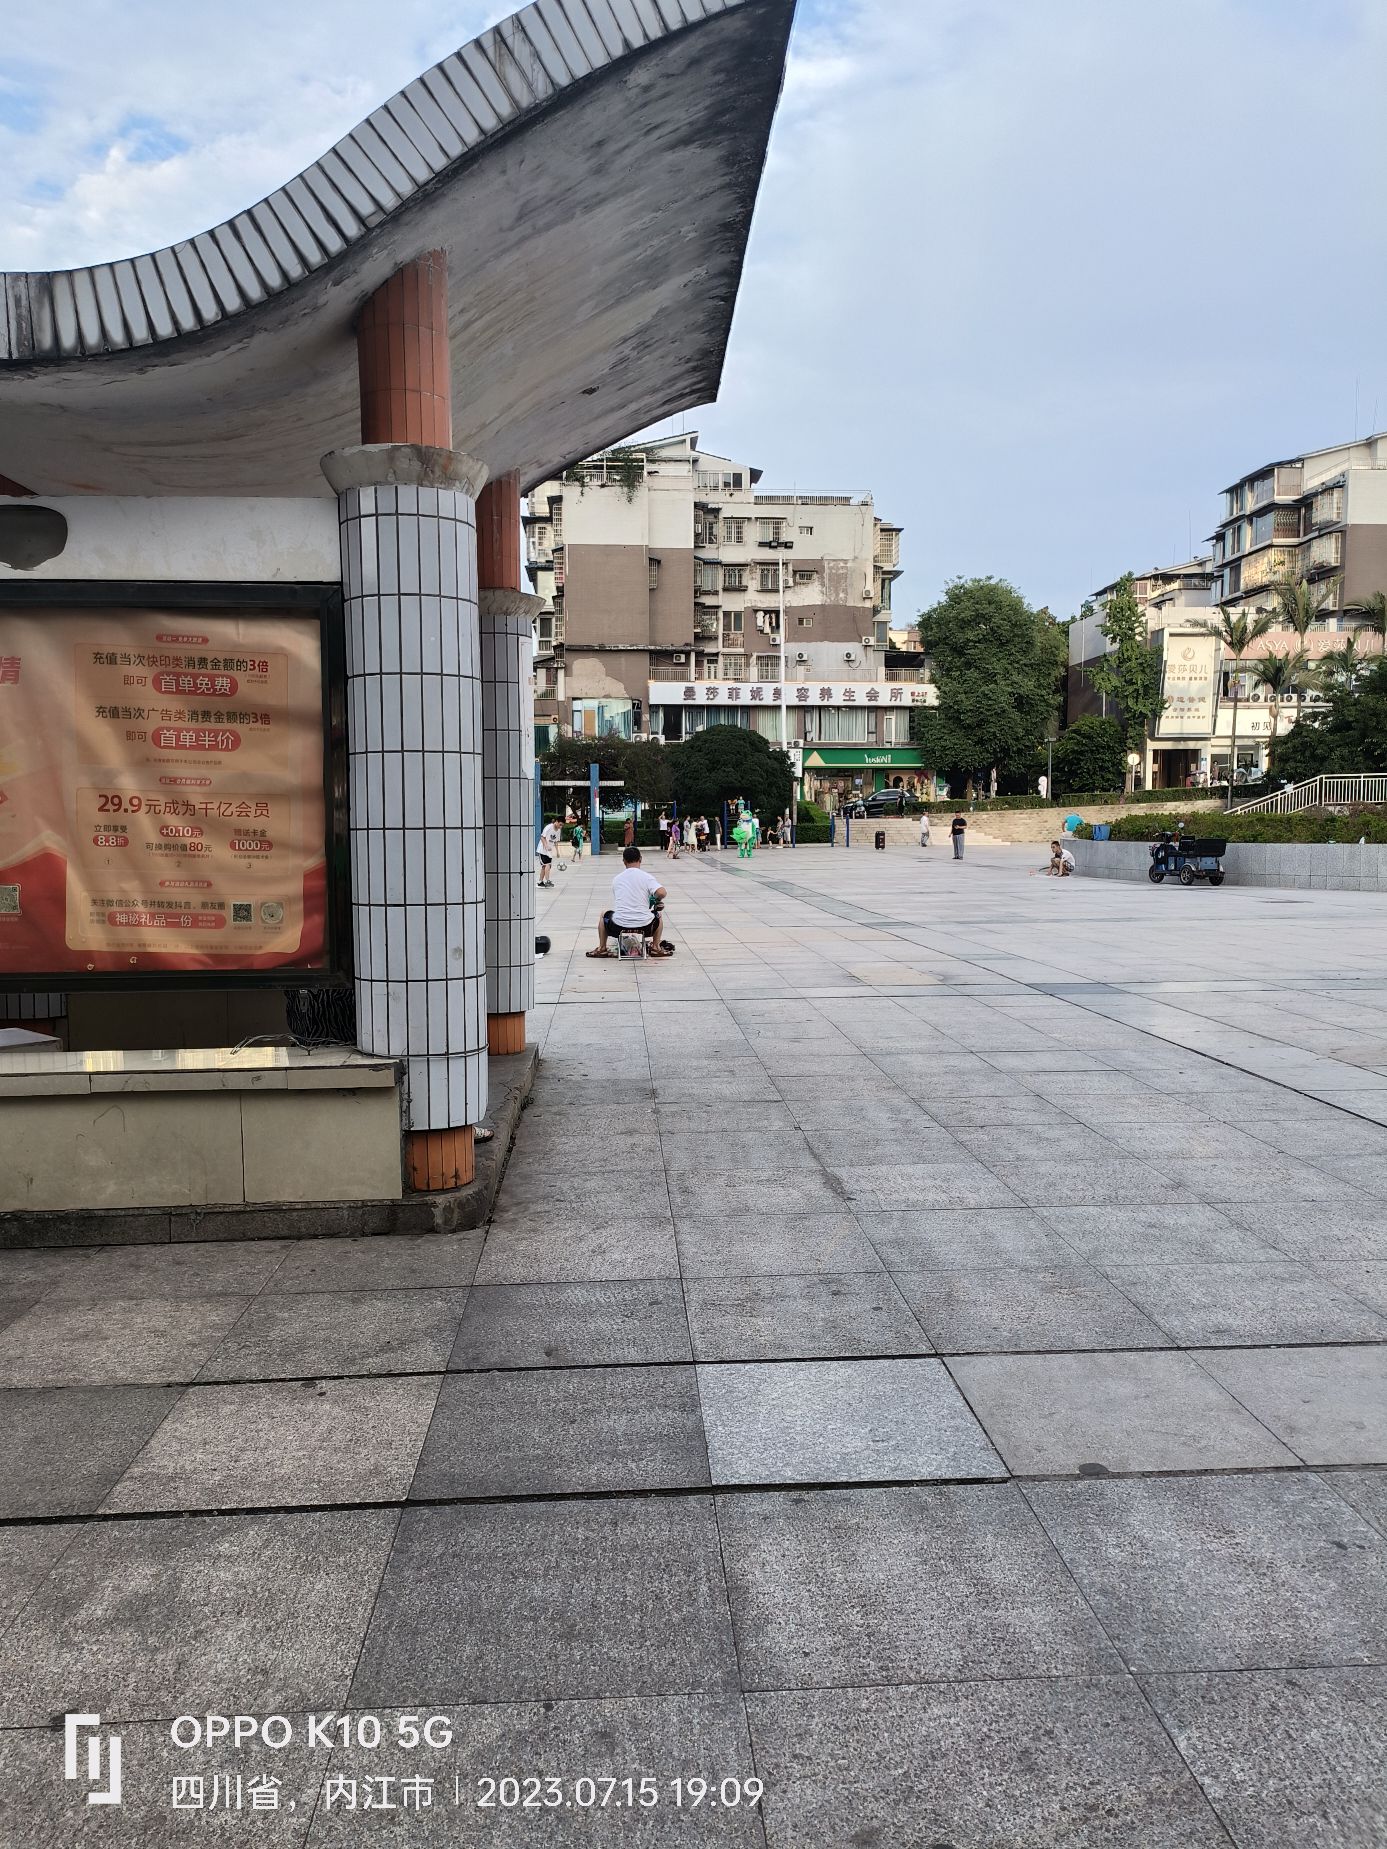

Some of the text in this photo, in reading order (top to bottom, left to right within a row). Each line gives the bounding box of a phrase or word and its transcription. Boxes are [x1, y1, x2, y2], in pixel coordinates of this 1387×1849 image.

[1257, 639, 1288, 650] ASYA
[92, 651, 270, 673] 充值当次快印类消费金额的3倍
[123, 674, 232, 695] 即可 首单免费
[95, 706, 271, 726] 充值当次广告类消费金额的3倍
[125, 730, 235, 750] 即可 首单半价
[97, 794, 271, 819] 29.9元成为千亿会员
[94, 824, 128, 834] 立即享受
[161, 826, 202, 838] +0.10元
[97, 835, 126, 847] 8.8折
[233, 839, 270, 851] 1000元
[115, 912, 193, 928] 神秘礼品一份
